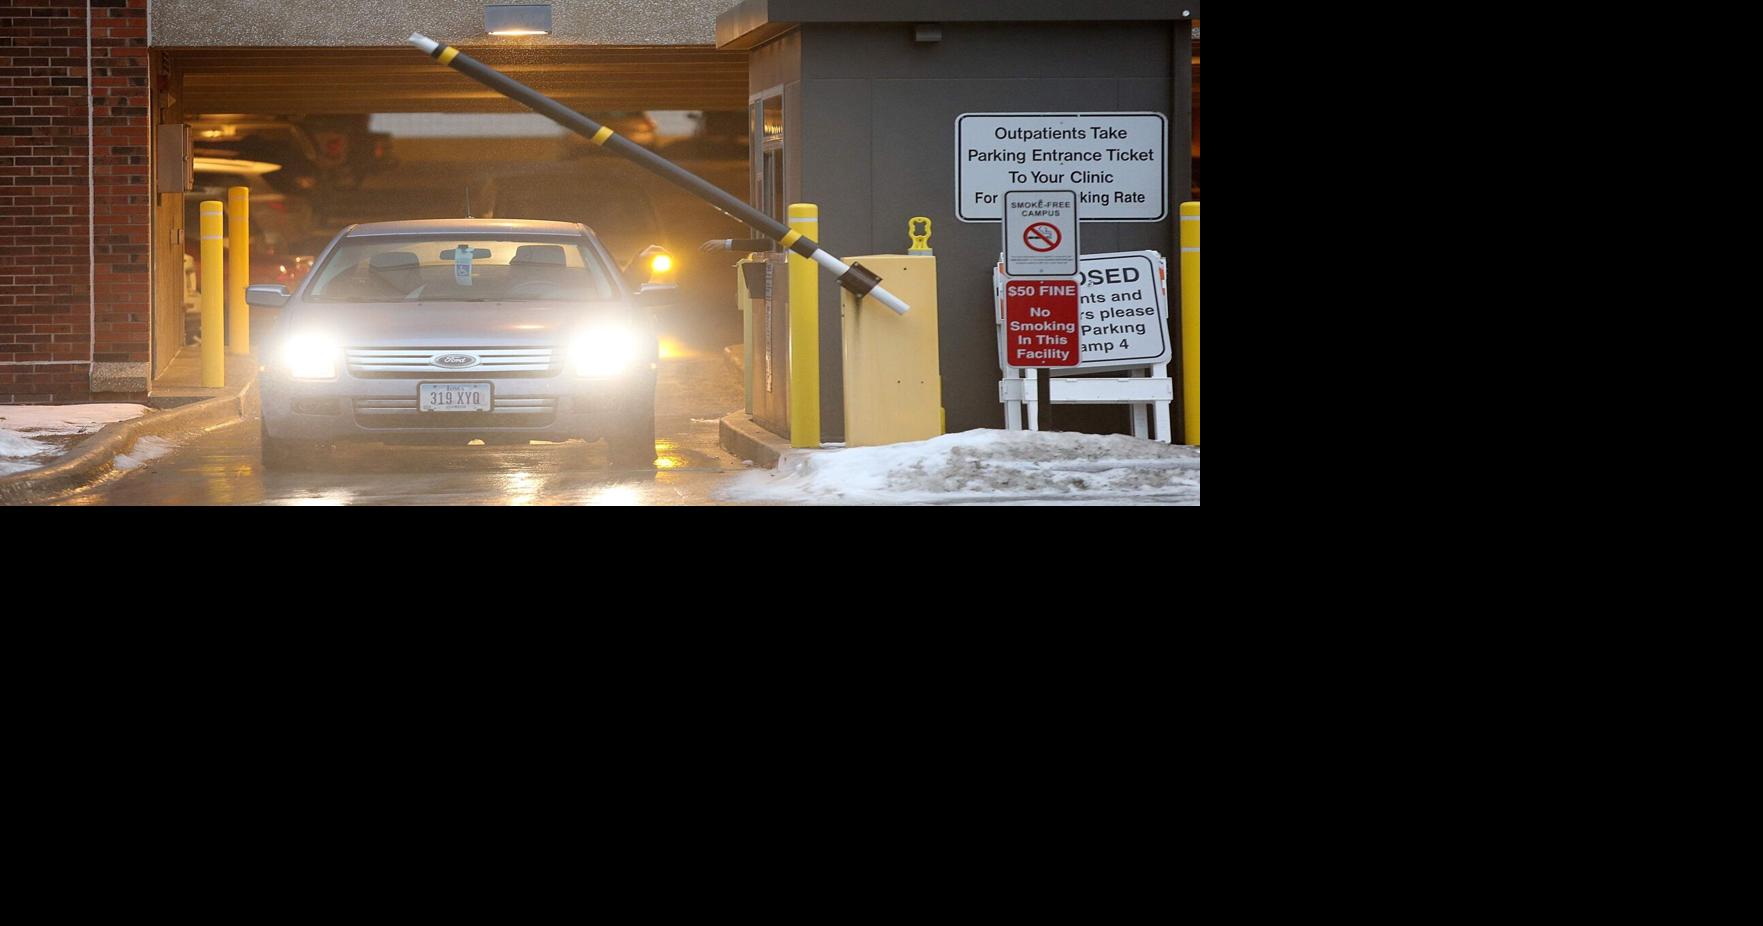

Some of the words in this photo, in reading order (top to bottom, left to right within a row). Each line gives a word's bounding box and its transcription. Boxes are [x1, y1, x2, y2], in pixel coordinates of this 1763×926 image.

[995, 127, 1086, 141] Outpatients
[1090, 127, 1127, 140] Take
[968, 150, 1026, 163] Parking
[1032, 150, 1102, 162] Entrance
[1106, 149, 1154, 161] Ticket
[1008, 171, 1027, 183] To
[1031, 171, 1064, 183] Your
[1070, 171, 1114, 183] Clinic
[975, 192, 998, 204] For
[1080, 192, 1110, 206] king
[1114, 192, 1145, 203] Rate
[1021, 209, 1061, 217] CAMPUS
[1008, 285, 1035, 297] $50
[1040, 286, 1076, 296] FINE
[1111, 290, 1142, 302] and
[1029, 307, 1051, 317] No
[1100, 307, 1155, 321] please
[1010, 321, 1075, 333] Smoking
[1082, 323, 1146, 336] Parking
[1018, 335, 1032, 345] In
[1036, 335, 1068, 345] This
[1119, 338, 1129, 350] 4
[1016, 349, 1070, 360] Facility
[430, 391, 453, 405] 319
